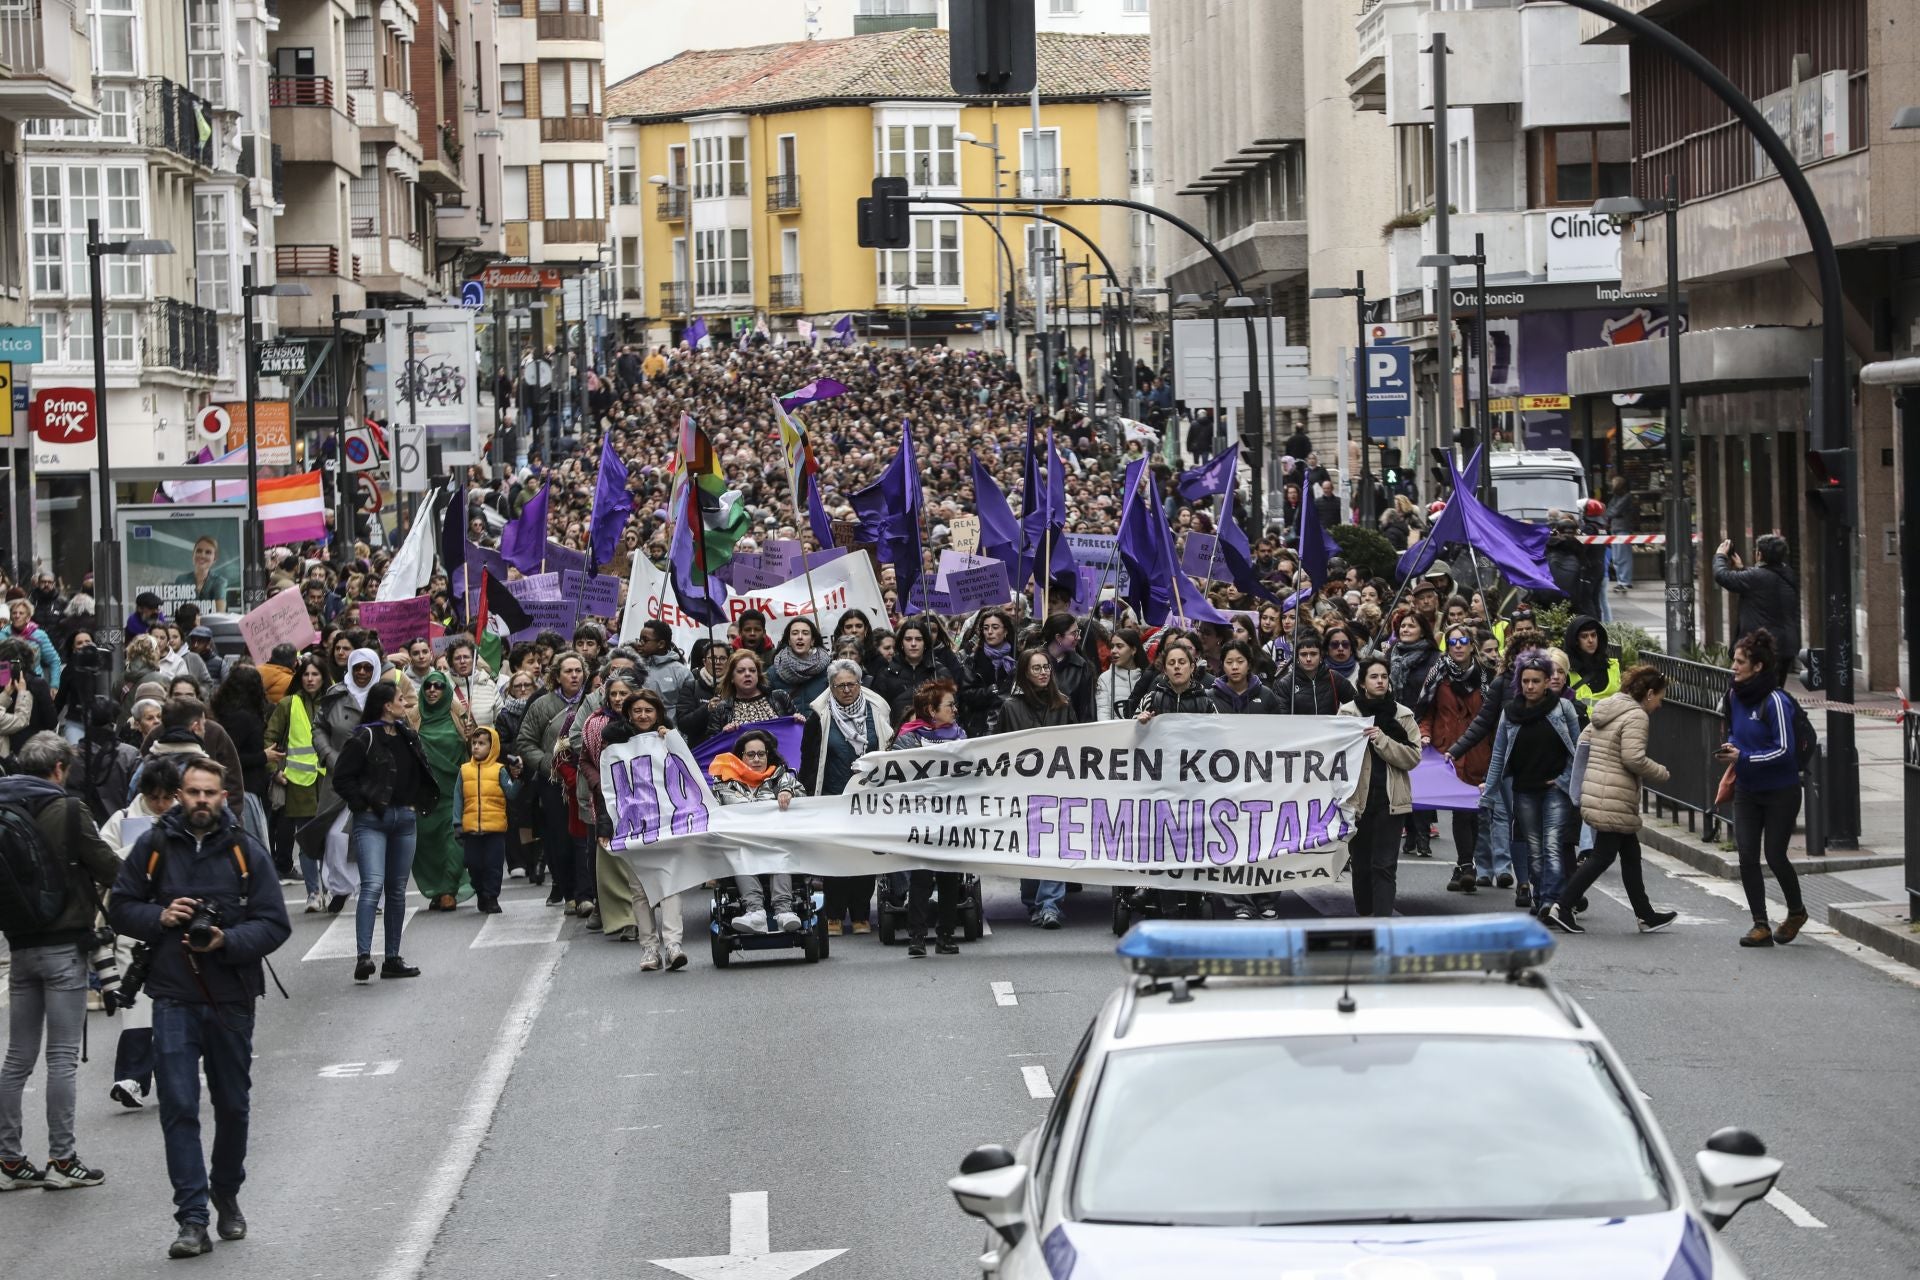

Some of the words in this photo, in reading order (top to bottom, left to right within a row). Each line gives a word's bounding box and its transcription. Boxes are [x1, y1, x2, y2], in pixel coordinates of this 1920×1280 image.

[1369, 353, 1397, 388] P
[1532, 398, 1561, 407] DHL
[953, 520, 977, 528] REAL
[1179, 749, 1349, 783] KONTRA
[850, 792, 969, 816] AUSARDIA
[981, 795, 1022, 818] ETA
[907, 825, 1020, 853] ALIANTZA
